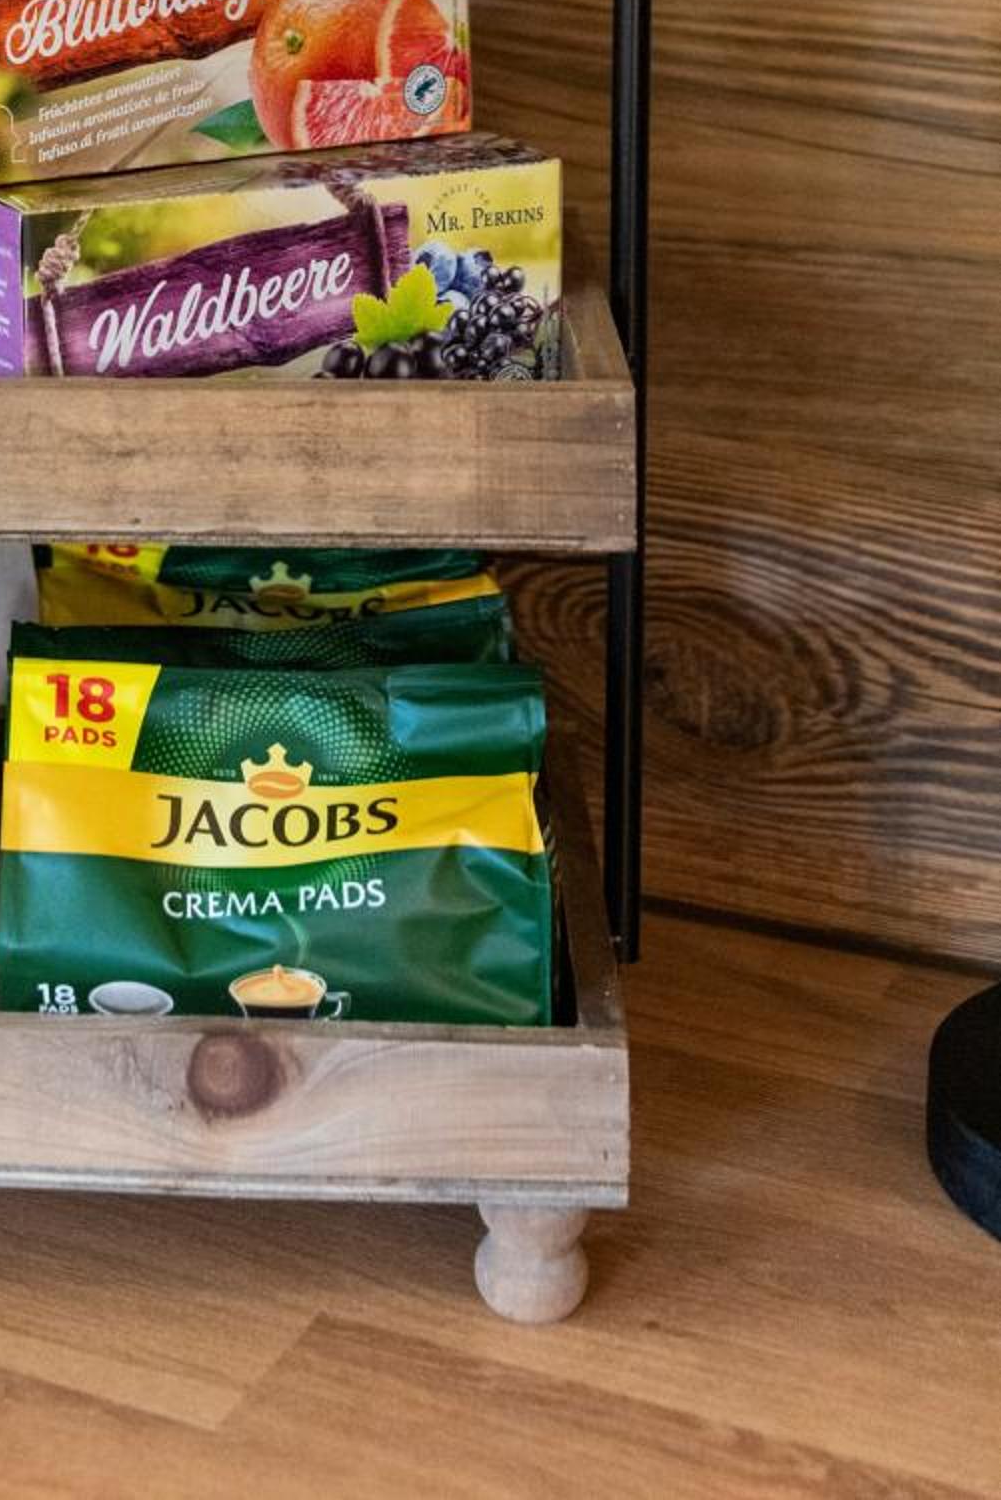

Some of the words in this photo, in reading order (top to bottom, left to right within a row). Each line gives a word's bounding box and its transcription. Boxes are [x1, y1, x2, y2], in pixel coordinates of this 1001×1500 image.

[88, 250, 355, 374] Waldbeere
[46, 672, 116, 724] 18
[43, 724, 117, 748] PADS
[151, 793, 399, 849] JACOBS
[163, 890, 284, 920] CREMA
[297, 878, 387, 912] PADS
[37, 982, 76, 1005] 18
